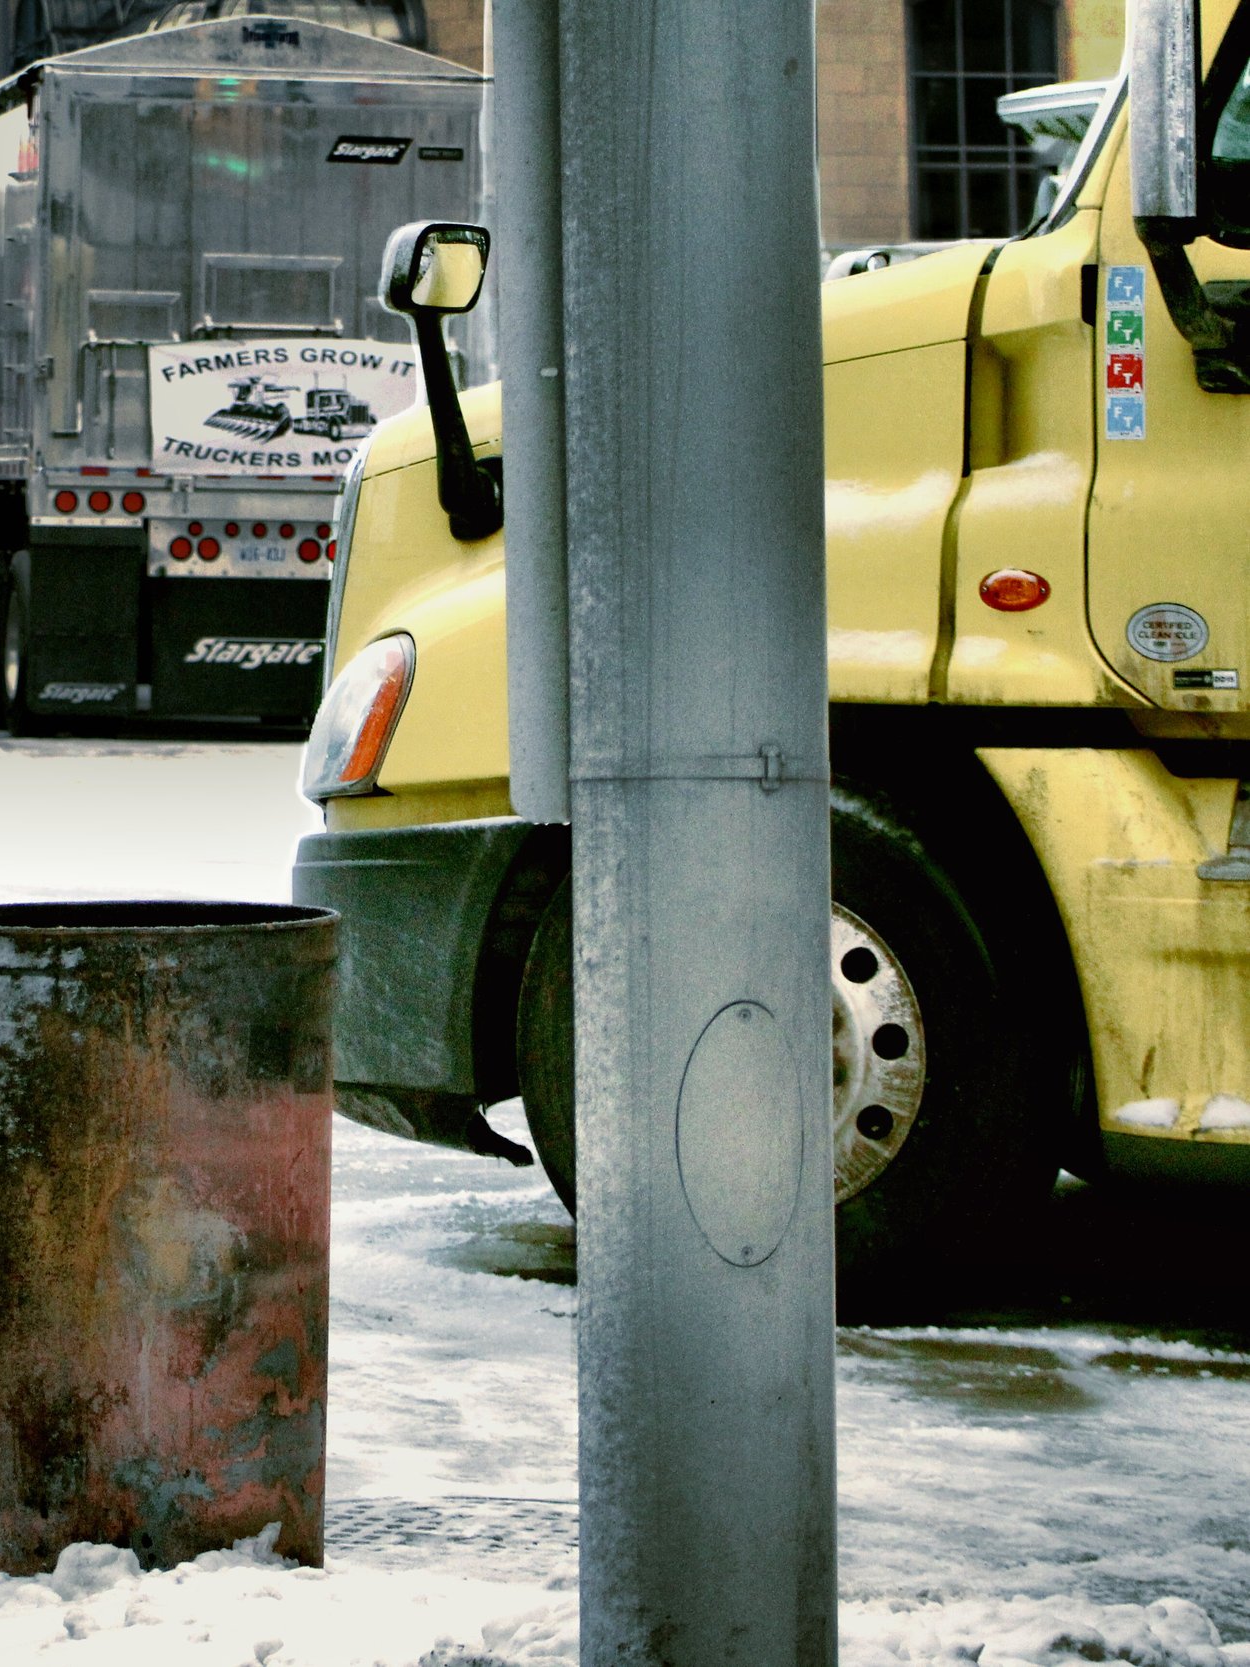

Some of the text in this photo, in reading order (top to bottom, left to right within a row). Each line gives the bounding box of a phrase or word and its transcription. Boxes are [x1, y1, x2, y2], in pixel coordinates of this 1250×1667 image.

[161, 347, 415, 383] FARMERS GROW IT
[162, 436, 359, 468] TRUCKERS MO
[184, 637, 323, 669] Stargate
